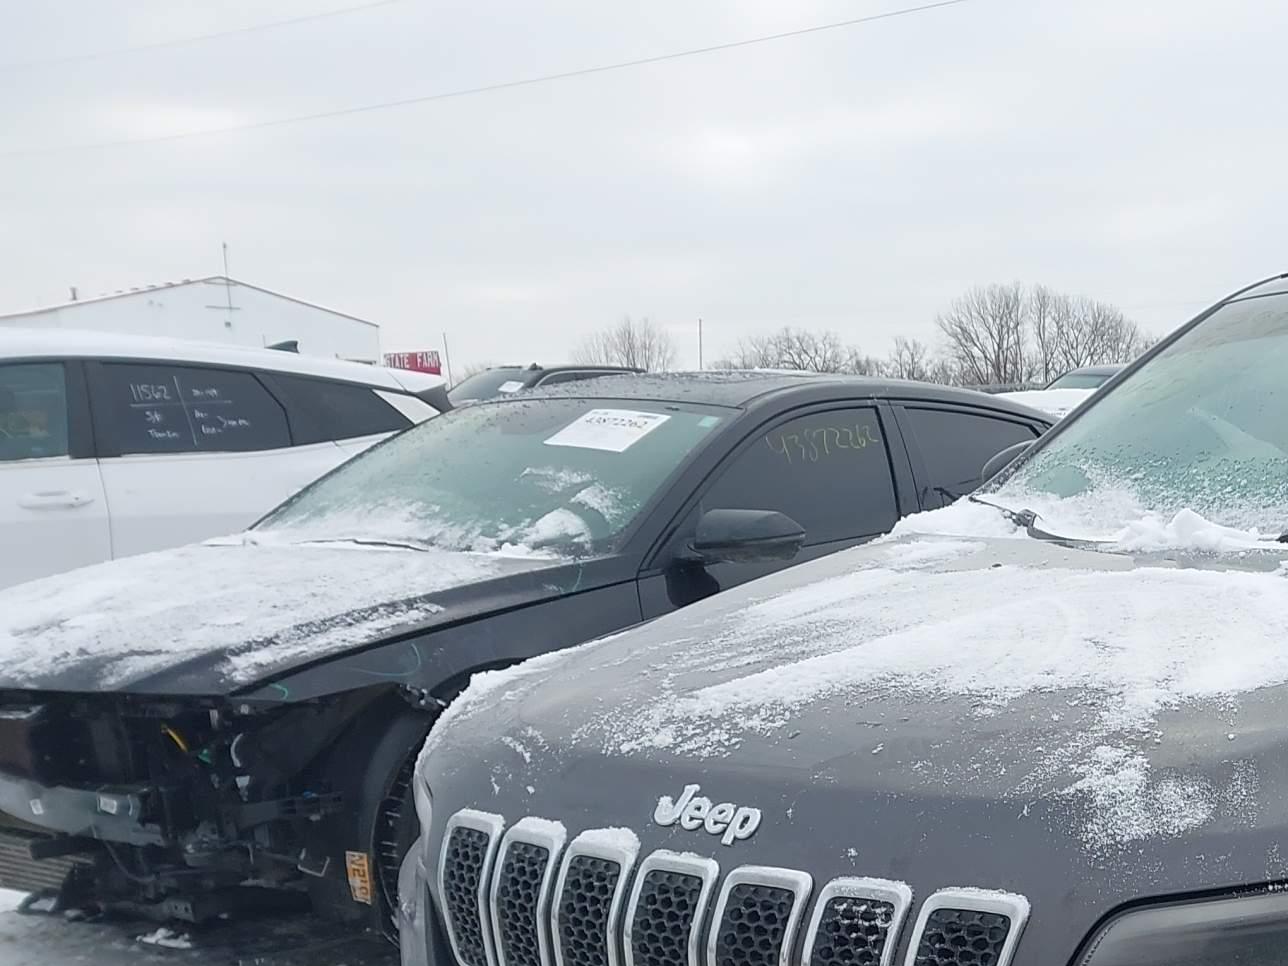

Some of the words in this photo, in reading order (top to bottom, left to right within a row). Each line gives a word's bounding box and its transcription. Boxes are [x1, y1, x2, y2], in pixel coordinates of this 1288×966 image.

[416, 351, 439, 368] FARM
[130, 383, 172, 401] 11562
[654, 784, 762, 846] Jeep
